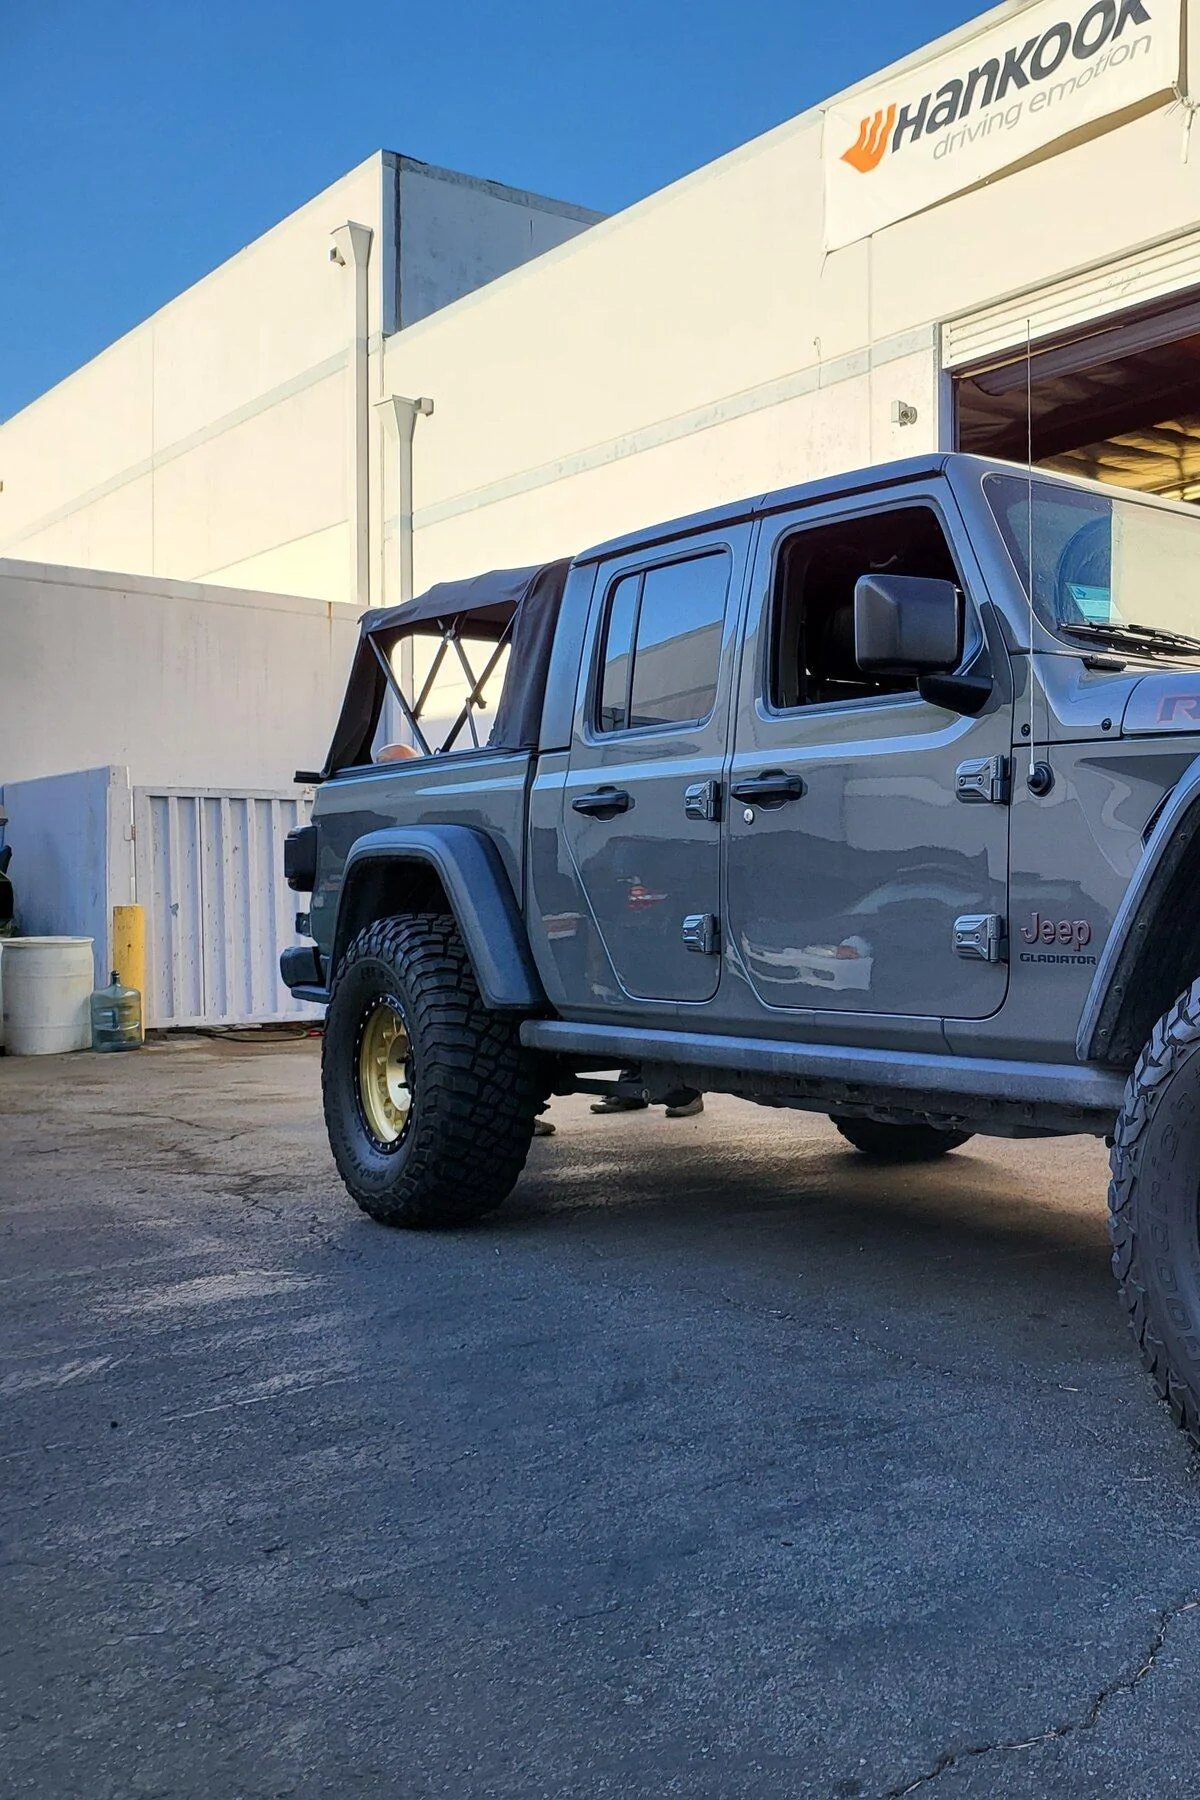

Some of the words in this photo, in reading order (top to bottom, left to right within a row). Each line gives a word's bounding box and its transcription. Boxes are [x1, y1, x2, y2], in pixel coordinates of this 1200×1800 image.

[933, 104, 1021, 160] driving
[1029, 34, 1152, 114] emotion
[1020, 911, 1092, 952] Jeep
[1020, 952, 1097, 965] GLADIATOR
